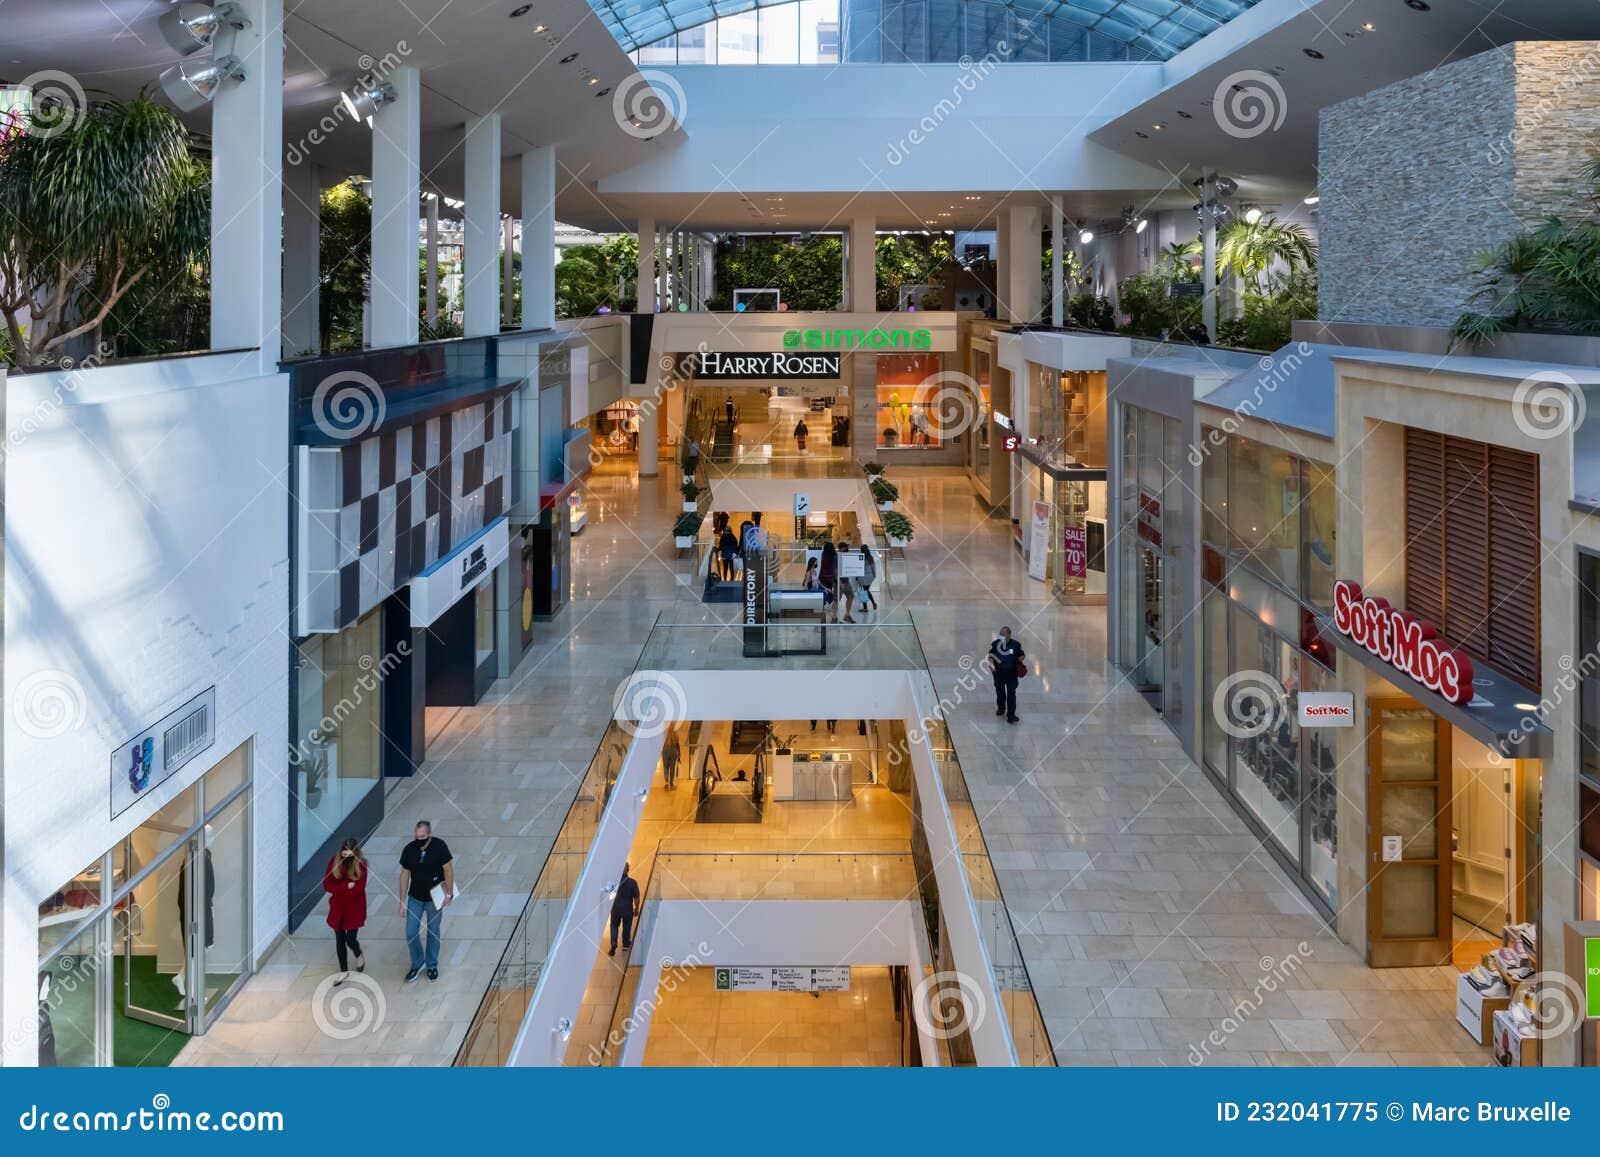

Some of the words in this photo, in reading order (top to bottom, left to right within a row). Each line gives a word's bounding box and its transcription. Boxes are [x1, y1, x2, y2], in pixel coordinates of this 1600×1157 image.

[804, 329, 932, 349] simons
[700, 352, 771, 375] HARRY
[771, 352, 840, 375] ROSEN
[1065, 529, 1085, 541] SALE
[746, 568, 757, 625] DIRECTORY
[717, 971, 728, 982] G
